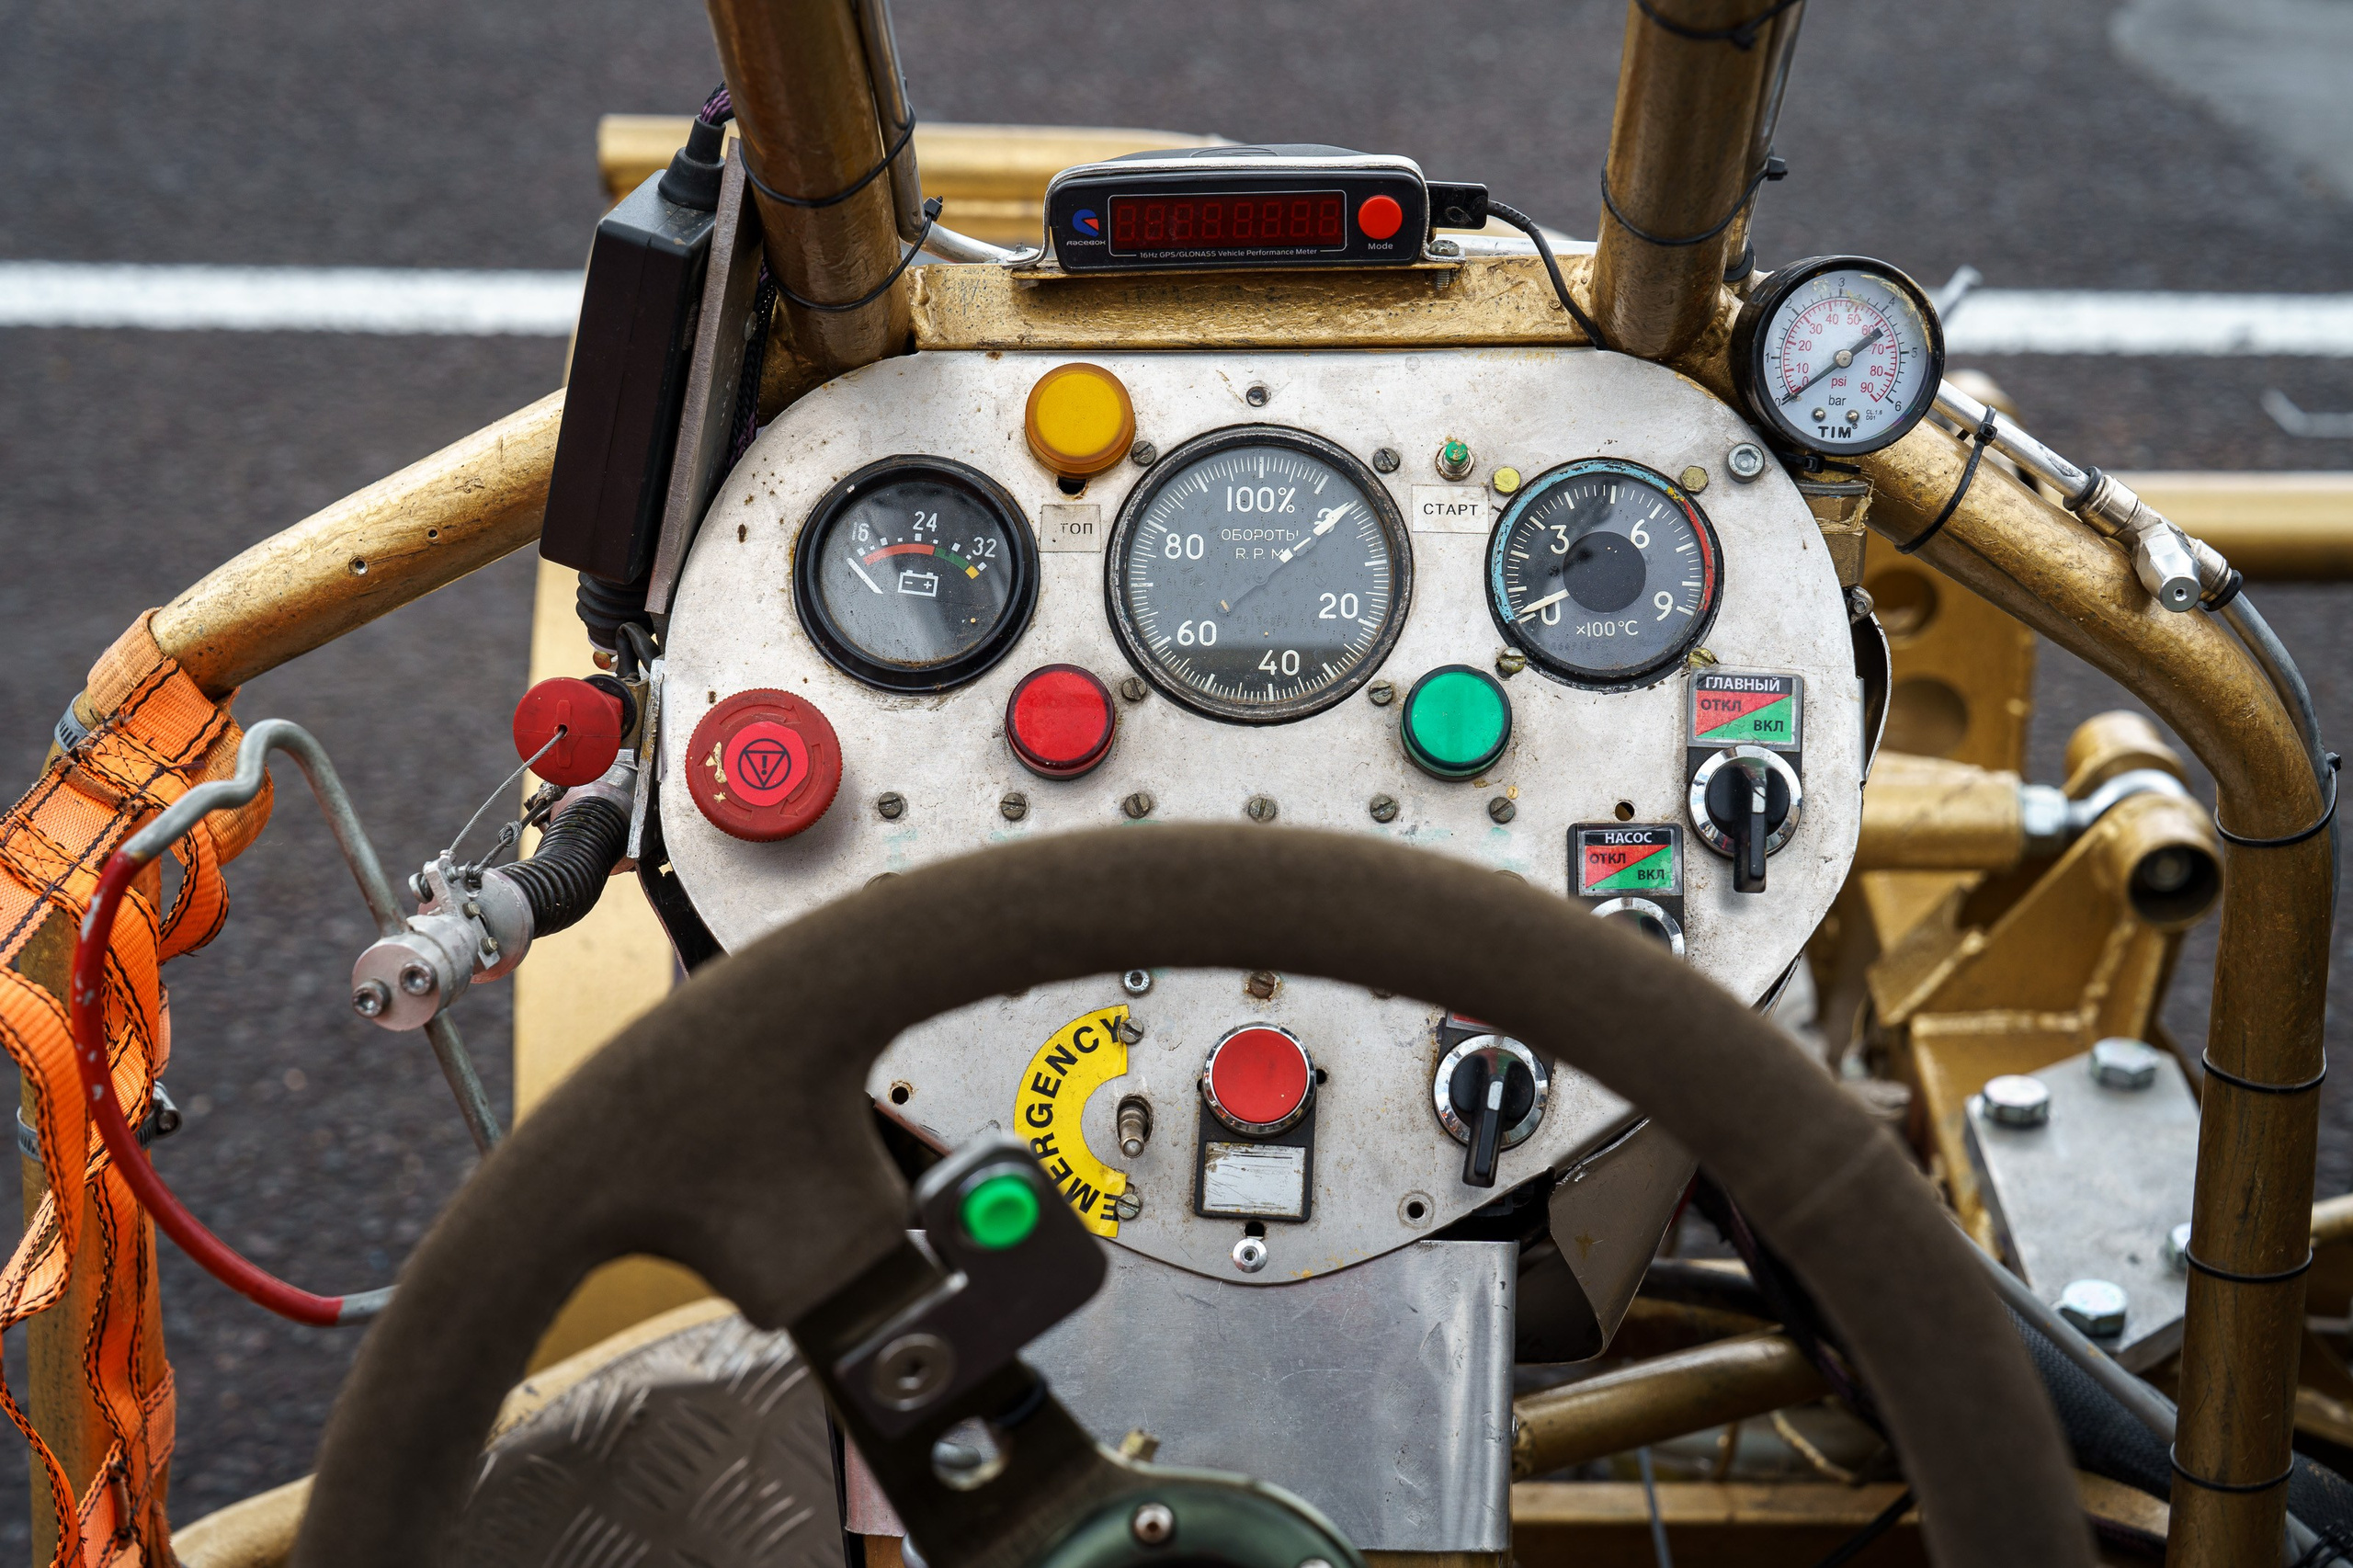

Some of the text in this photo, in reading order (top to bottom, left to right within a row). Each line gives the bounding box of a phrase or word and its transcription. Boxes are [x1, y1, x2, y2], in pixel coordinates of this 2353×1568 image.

[1368, 242, 1393, 250] Mode
[1159, 250, 1217, 258] GPS/GLONASS
[1246, 248, 1294, 256] Performance
[1838, 277, 1846, 288] 3
[1785, 298, 1793, 310] 2
[1888, 297, 1896, 306] 4
[1825, 313, 1839, 324] 40
[1847, 313, 1860, 324] 50
[1809, 324, 1823, 335] 30
[1861, 324, 1875, 335] 60
[1798, 340, 1813, 351] 20
[1871, 344, 1884, 355] 70
[1911, 347, 1918, 358] 5
[1796, 362, 1810, 374] 10
[1870, 365, 1883, 377] 80
[1831, 375, 1847, 389] psi
[1859, 382, 1874, 393] 90
[1828, 394, 1847, 406] bar
[1894, 402, 1903, 412] 6
[1226, 485, 1297, 514] 100%
[1423, 502, 1480, 517] СТАРТ
[913, 511, 938, 532] 24
[1221, 528, 1299, 541] ОБОРОТЫ
[1549, 524, 1571, 555] 3
[1630, 518, 1651, 550] 6
[972, 536, 997, 559] 32
[1164, 532, 1205, 561] 80
[1319, 592, 1359, 619] 20
[1654, 590, 1675, 622] 9
[1176, 619, 1218, 647] 60
[1257, 649, 1301, 676] 40
[1705, 676, 1780, 692] ГЛАВНЫЙ
[1700, 699, 1742, 713] ОТКЛ
[1753, 719, 1784, 733] ВКЛ
[1605, 831, 1653, 845] НАСОС
[1589, 852, 1627, 865] ОТКЛ
[1637, 869, 1665, 881] ВКЛ
